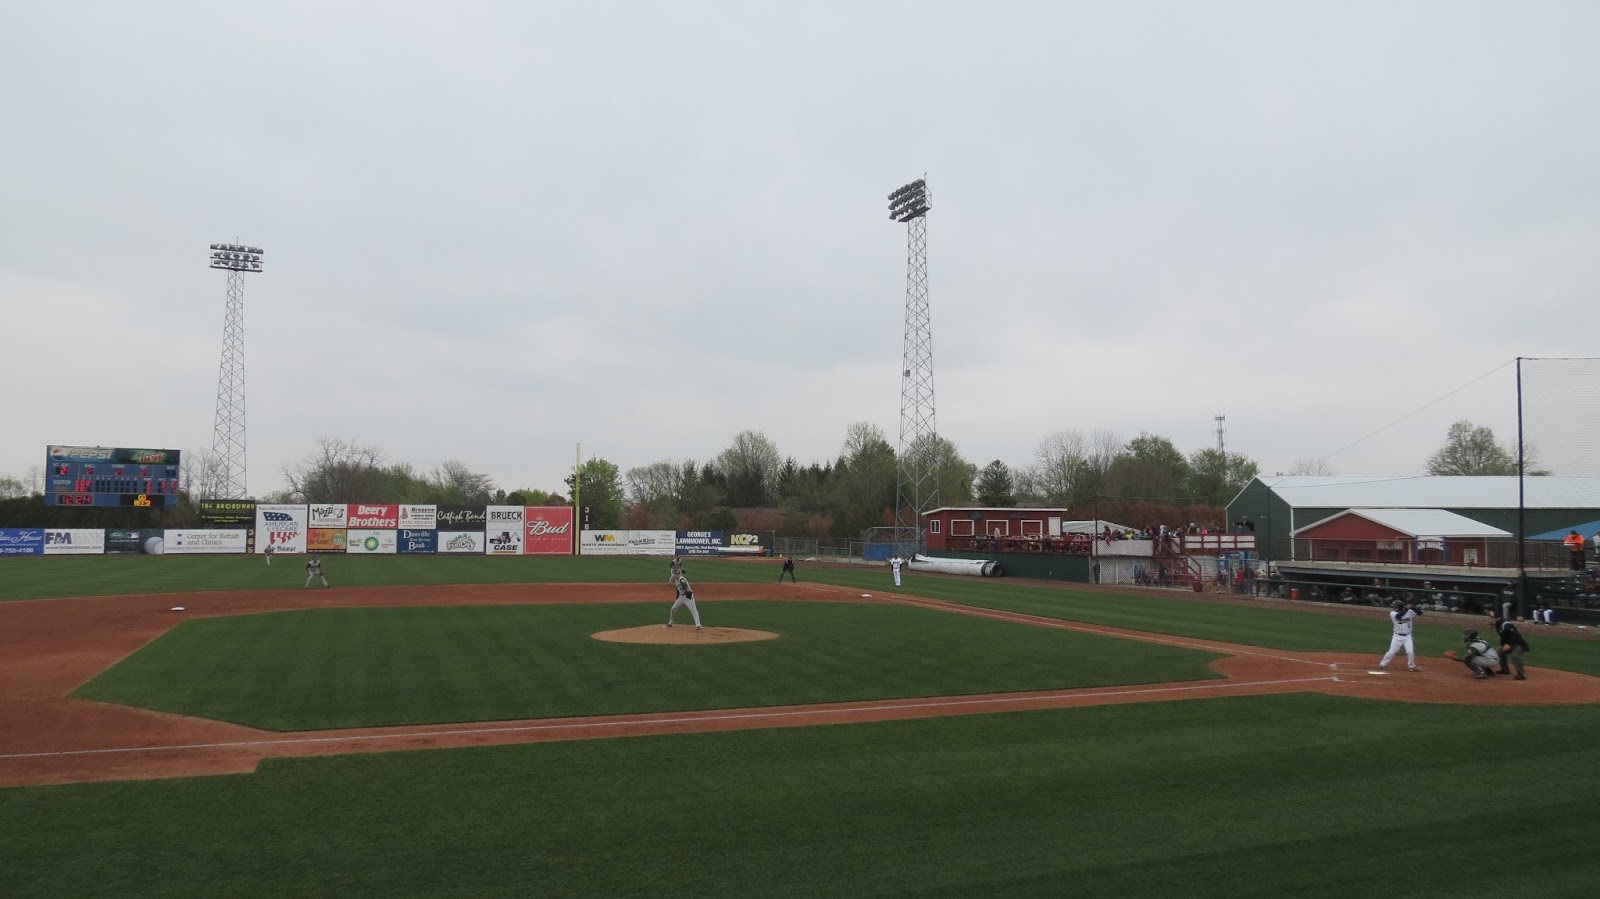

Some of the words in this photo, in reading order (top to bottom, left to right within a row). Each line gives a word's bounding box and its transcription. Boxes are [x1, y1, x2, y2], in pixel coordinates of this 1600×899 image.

[70, 448, 113, 459] PEPSI
[357, 505, 388, 516] Deery
[491, 511, 523, 520] BRUECK
[348, 516, 396, 527] Brothers
[437, 510, 463, 525] Catfish
[463, 510, 486, 520] Bend
[526, 520, 570, 536] Bud
[45, 532, 72, 544] F&M
[402, 529, 431, 539] Danville
[408, 541, 426, 551] Bank
